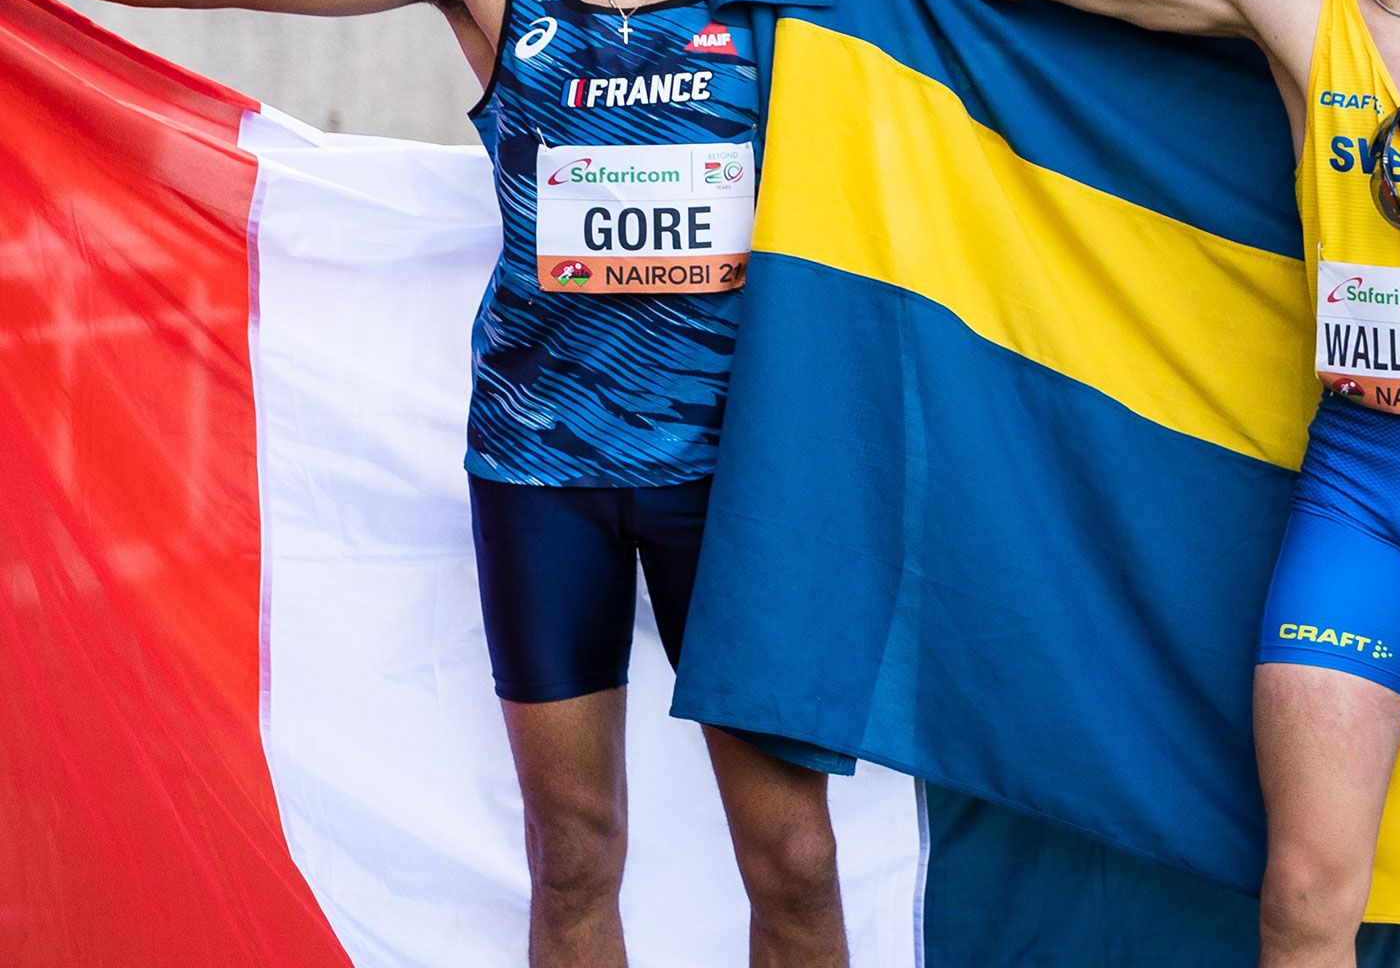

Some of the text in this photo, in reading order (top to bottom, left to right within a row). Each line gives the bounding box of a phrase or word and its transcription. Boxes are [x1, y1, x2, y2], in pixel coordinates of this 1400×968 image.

[693, 33, 731, 47] MAIF
[587, 71, 713, 108] FRANCE
[707, 152, 739, 160] BEYOND
[571, 167, 680, 183] Safaricom
[584, 206, 713, 251] GORE
[606, 263, 744, 285] NAIROBI 21
[1279, 623, 1371, 652] CRAFT
